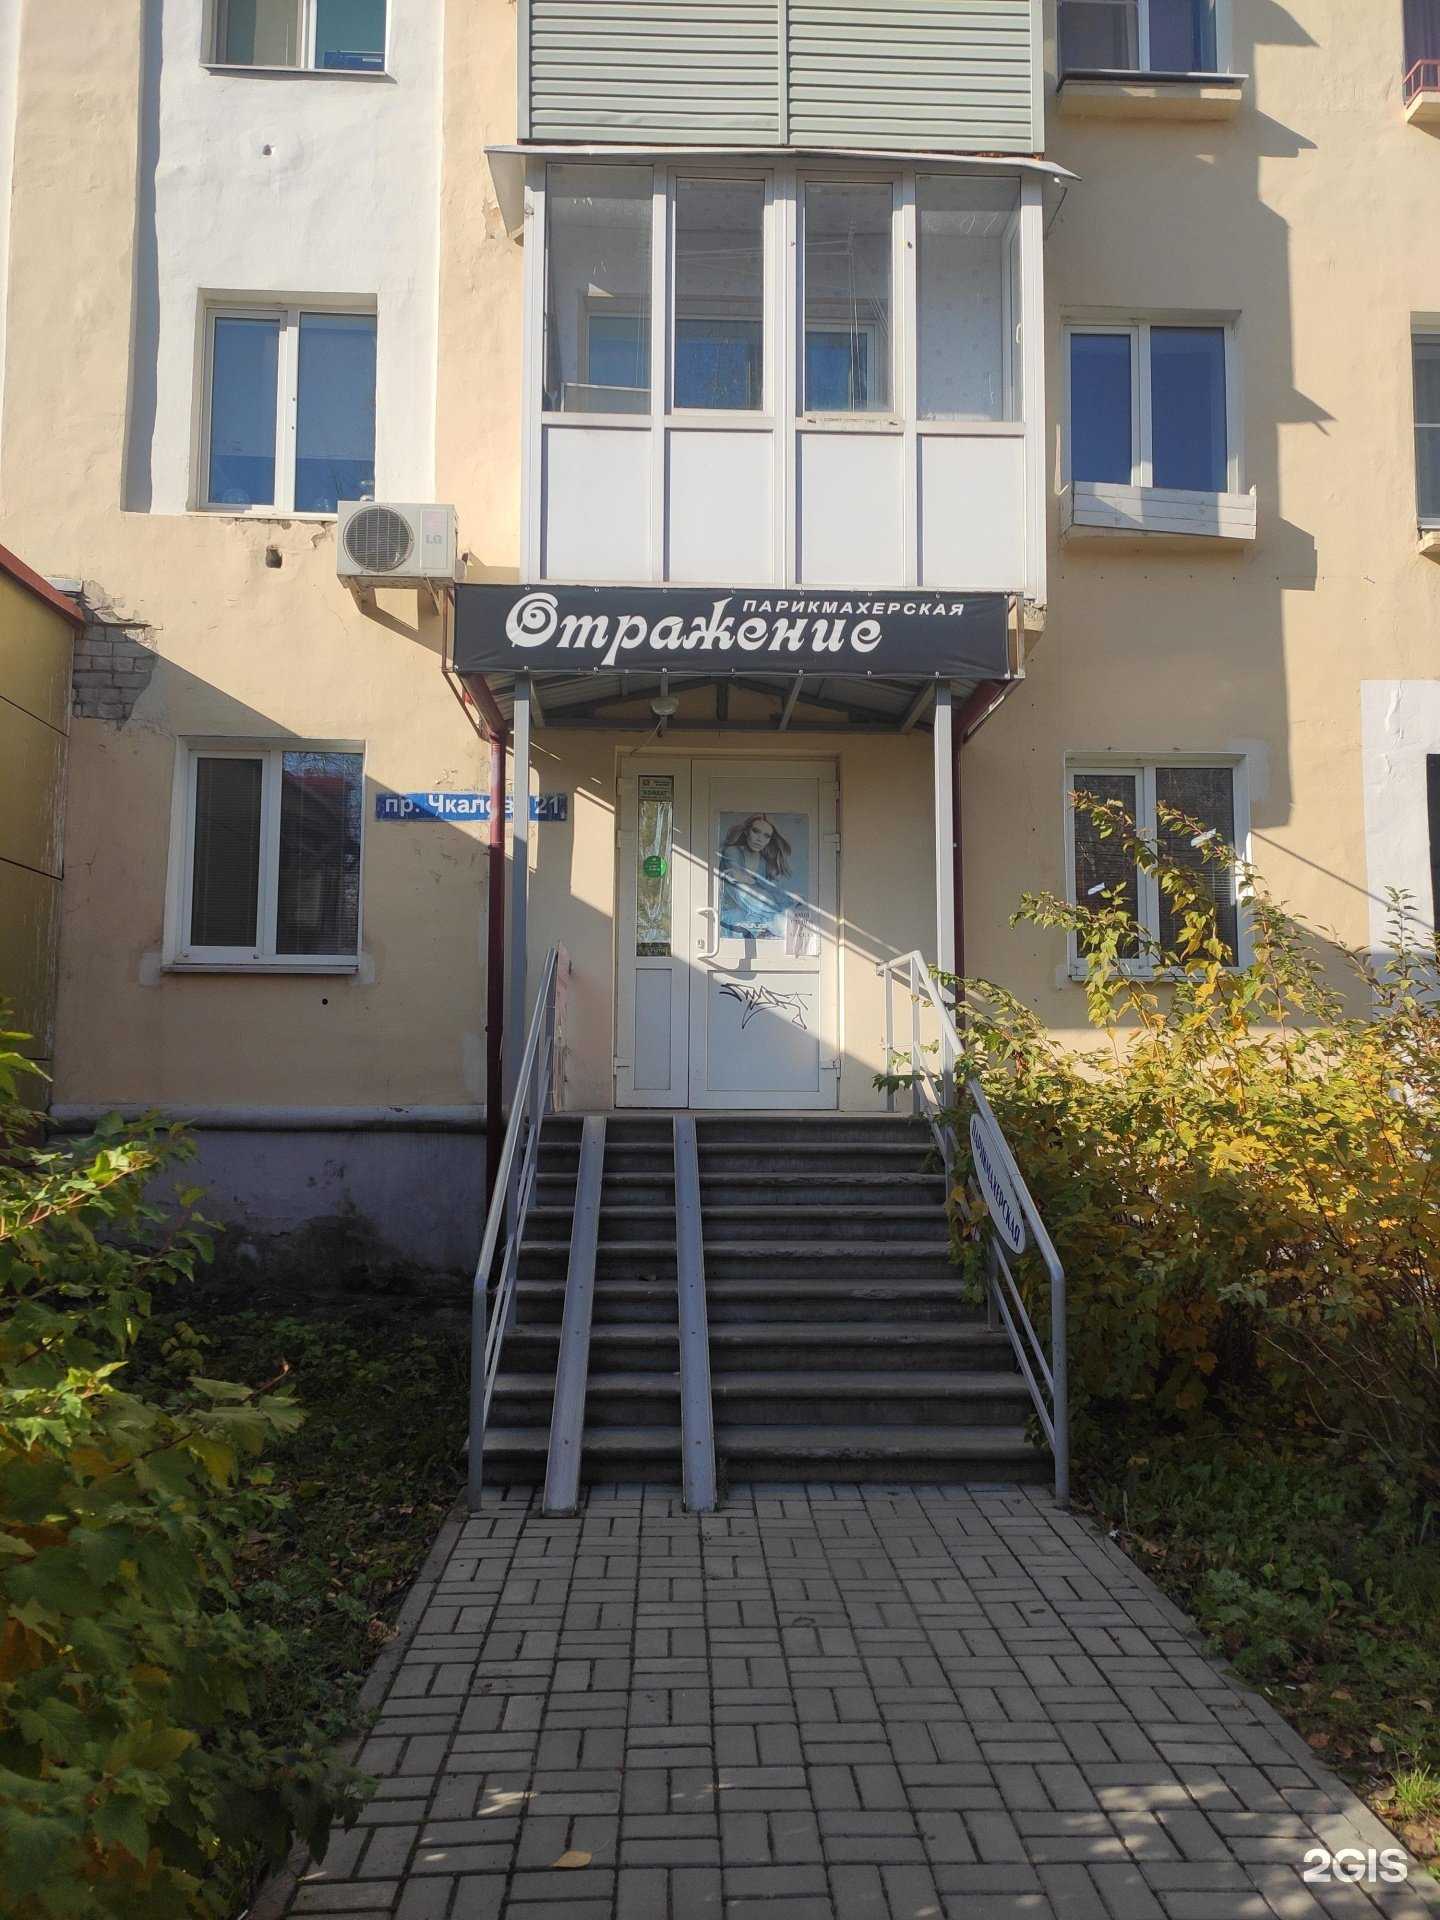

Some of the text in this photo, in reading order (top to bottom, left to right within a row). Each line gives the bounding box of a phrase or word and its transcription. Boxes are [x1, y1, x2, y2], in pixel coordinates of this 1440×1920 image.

[425, 534, 442, 544] LG
[742, 599, 964, 617] ПАРИКМАХЕРСКАЯ
[505, 592, 882, 665] Отражение
[385, 794, 559, 816] пр. Чкалв 21
[971, 1119, 1021, 1247] ПАРИКМАХЕРСКАЯ
